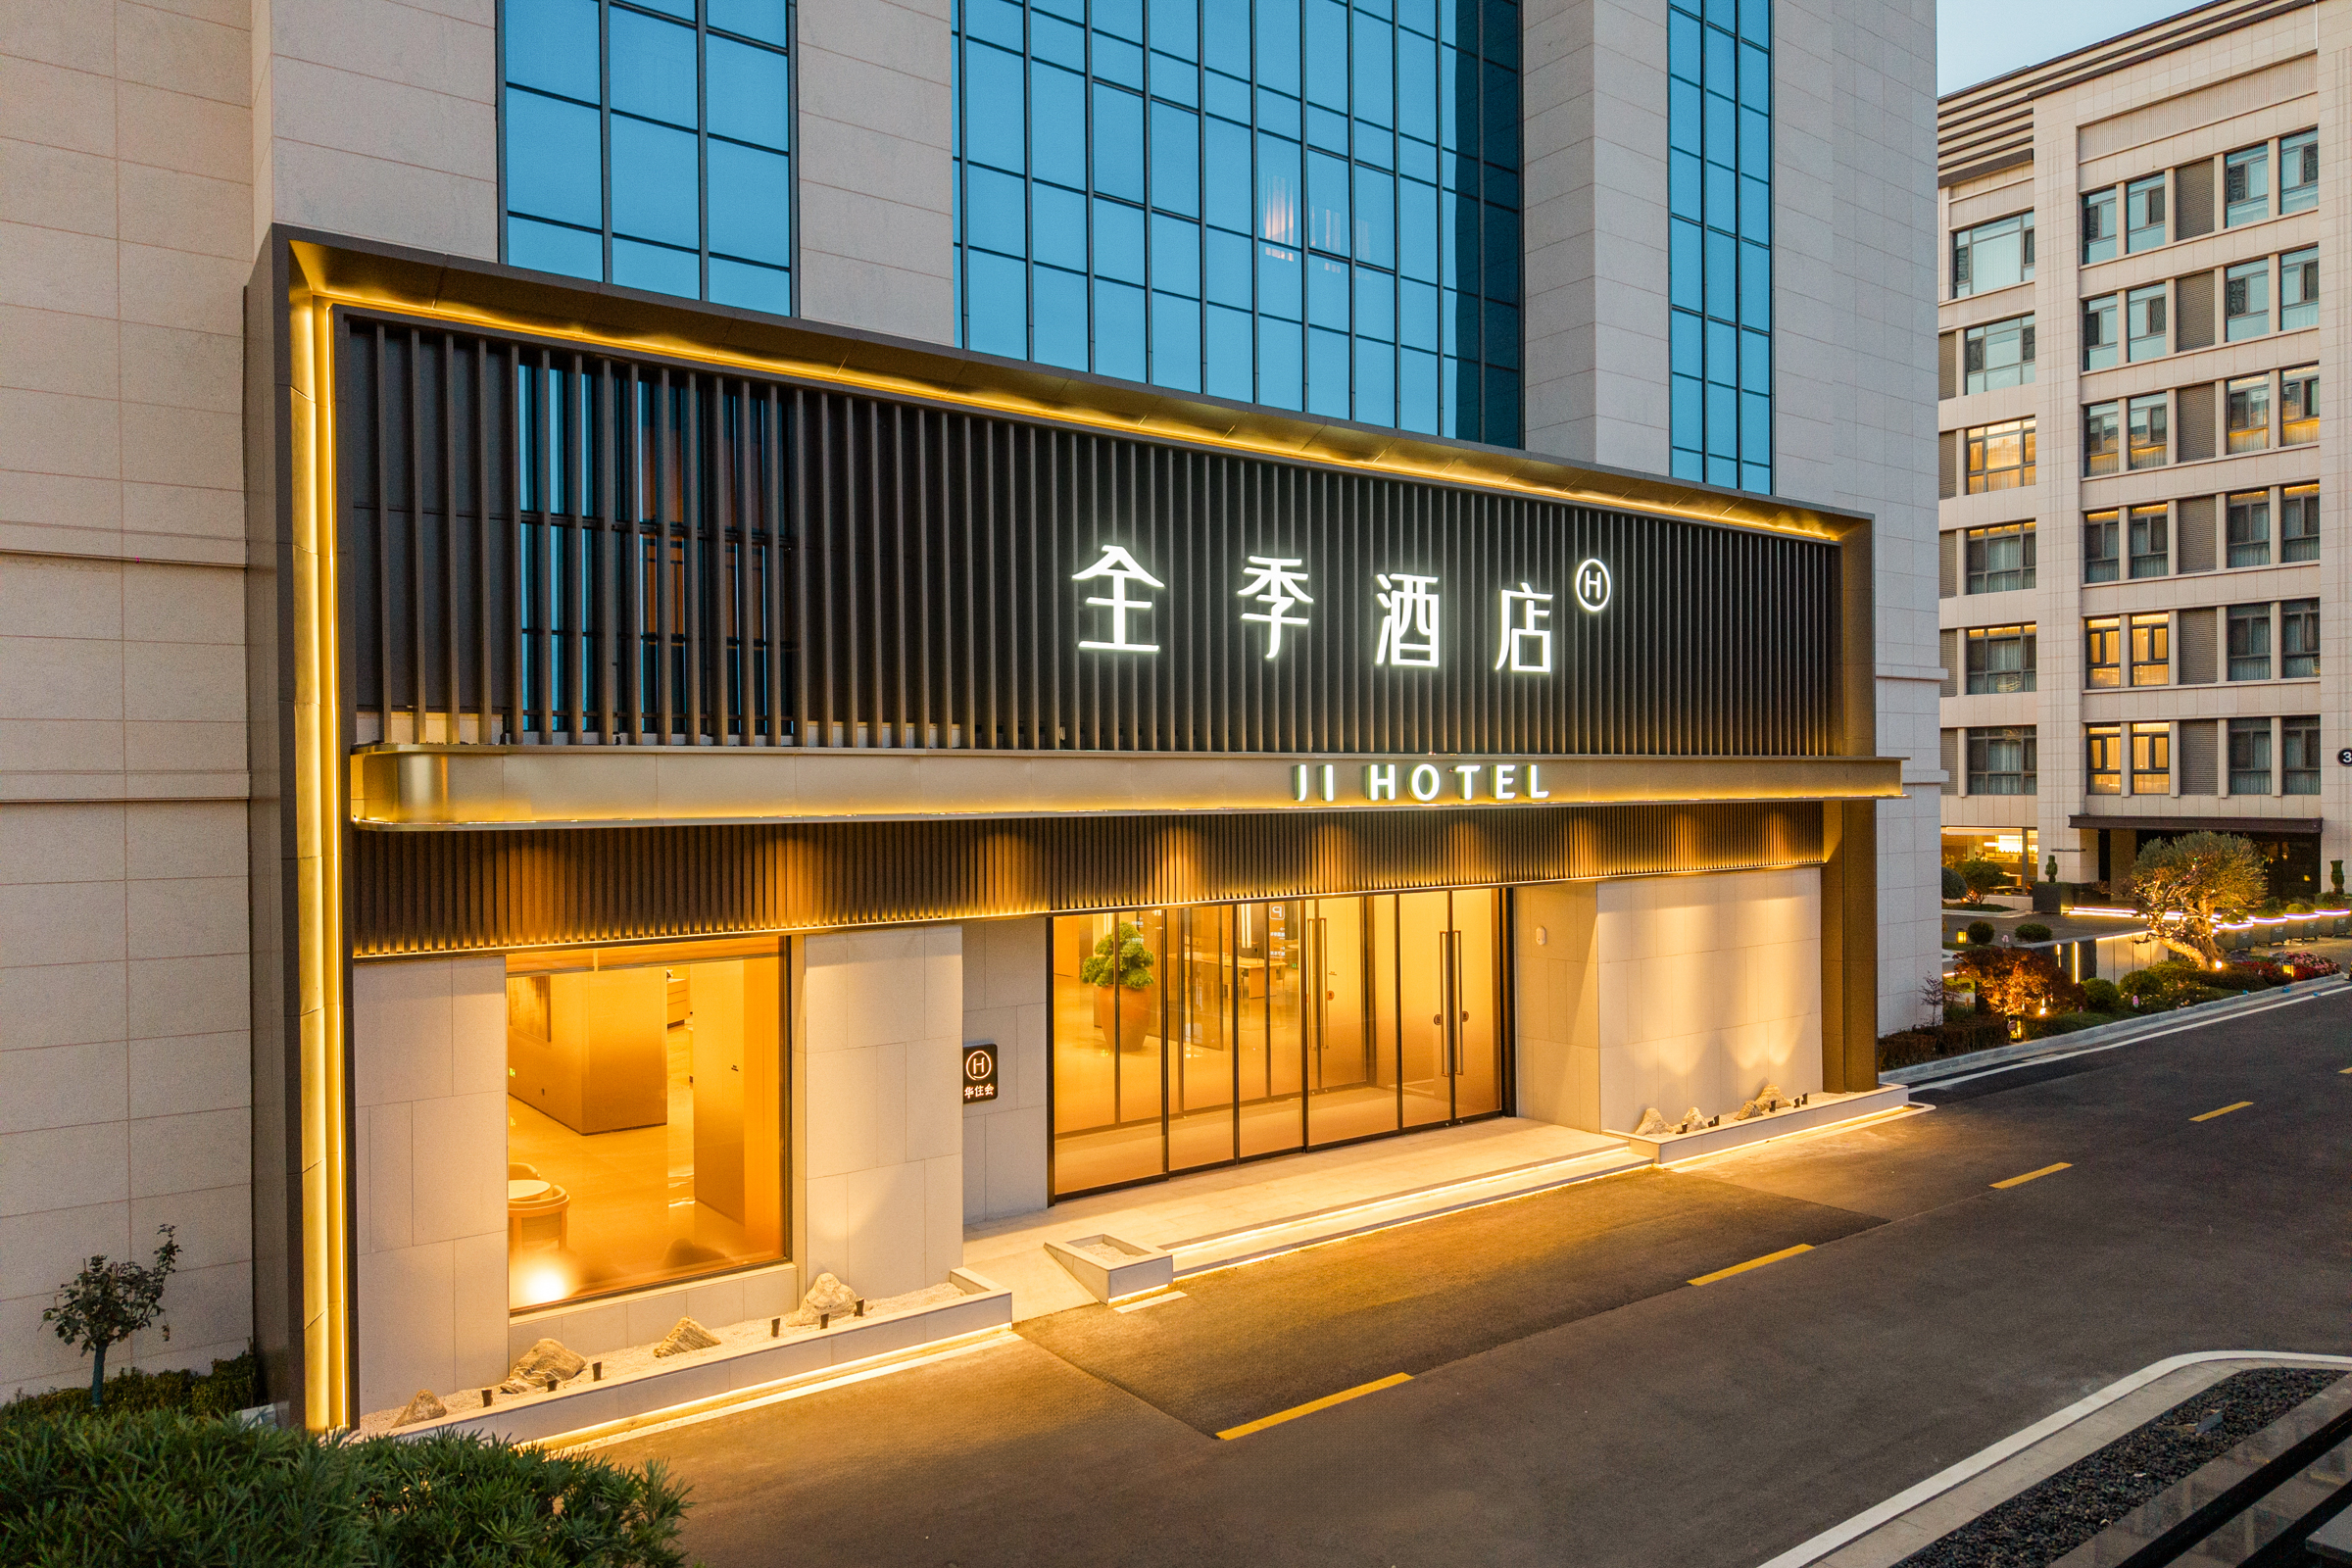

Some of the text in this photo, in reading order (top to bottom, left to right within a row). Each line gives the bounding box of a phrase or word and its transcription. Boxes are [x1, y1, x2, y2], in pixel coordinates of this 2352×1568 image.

[1071, 544, 1553, 673] 全季酒店
[2342, 751, 2352, 763] 3
[1296, 763, 1549, 802] JI HOTEL
[964, 1083, 995, 1100] 华住会
